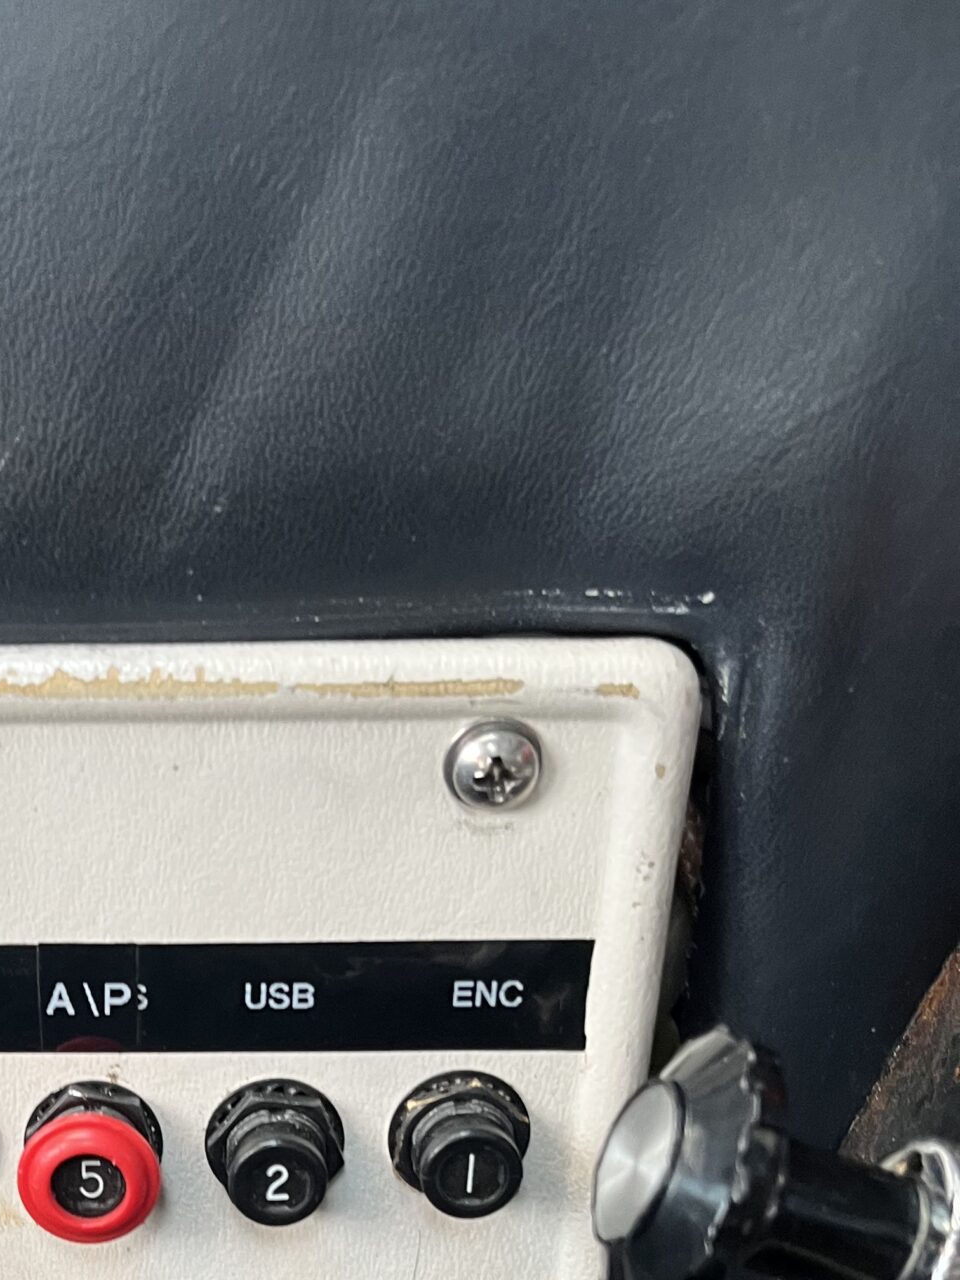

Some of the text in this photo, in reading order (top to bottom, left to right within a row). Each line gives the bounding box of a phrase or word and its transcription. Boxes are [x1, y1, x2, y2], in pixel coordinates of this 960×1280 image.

[244, 982, 315, 1010] USB
[452, 980, 524, 1008] ENC
[78, 1160, 105, 1199] 5
[265, 1163, 291, 1201] 2
